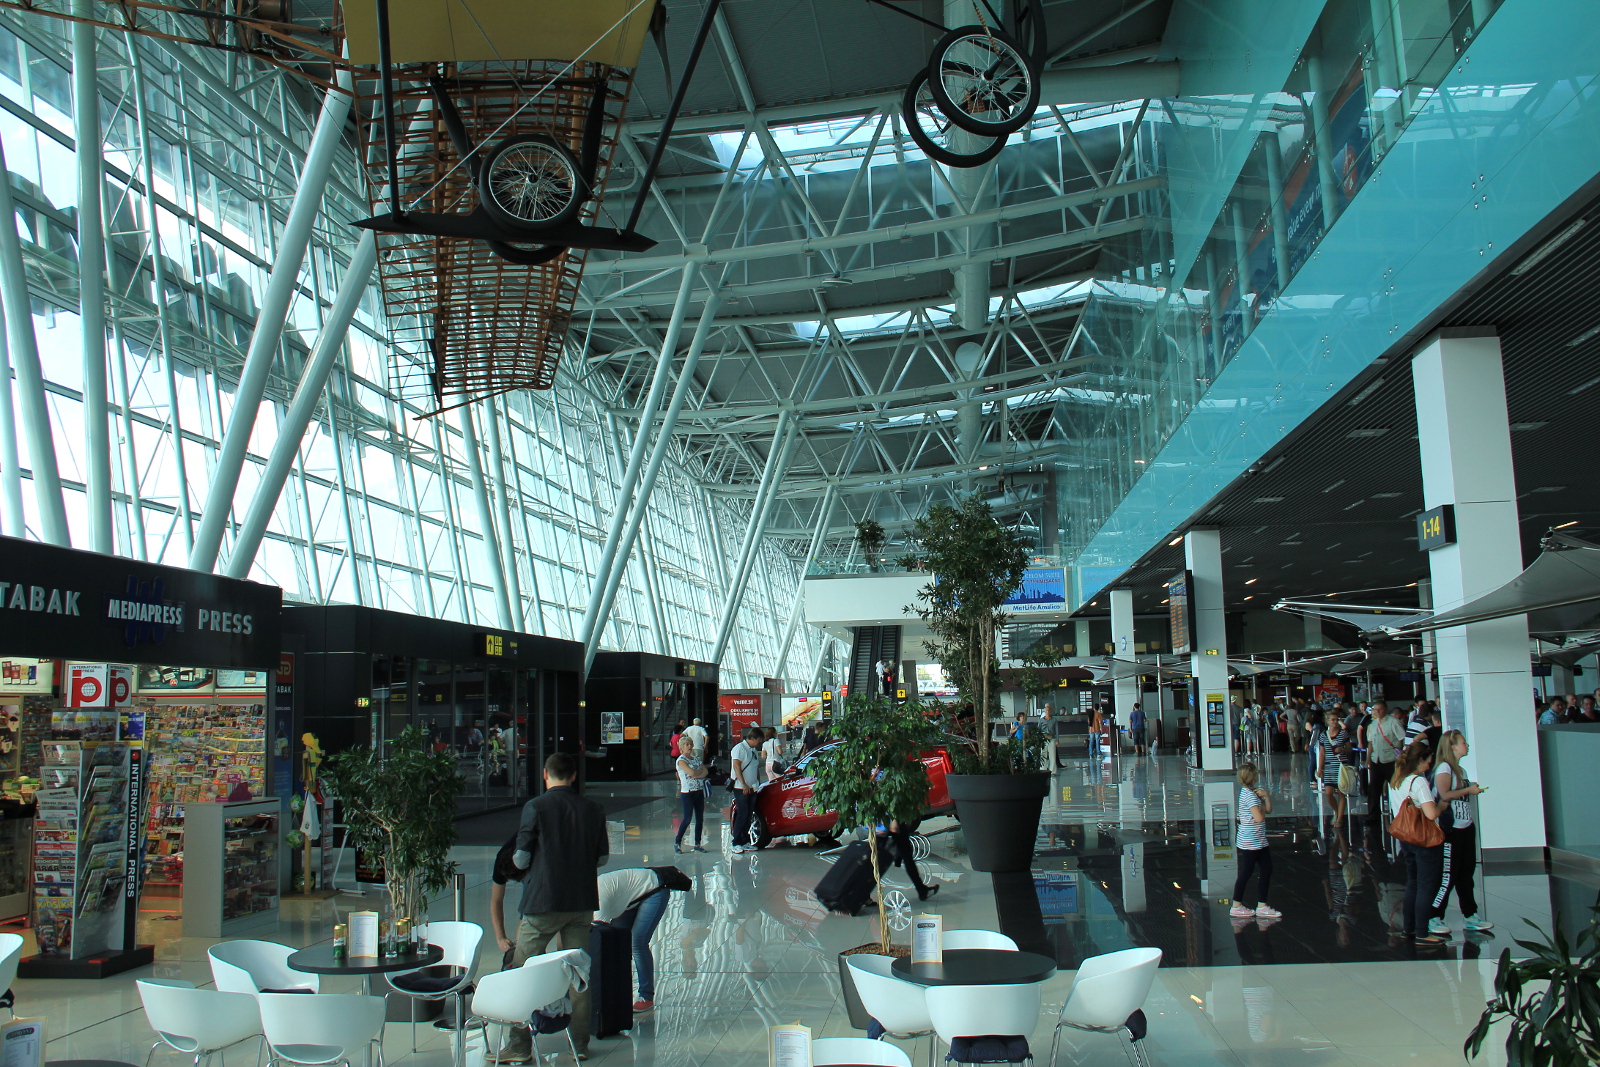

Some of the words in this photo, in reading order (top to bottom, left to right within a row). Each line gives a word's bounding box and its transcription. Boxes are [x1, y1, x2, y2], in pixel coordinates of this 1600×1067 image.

[1287, 216, 1300, 242] alue
[1422, 515, 1440, 540] 1-14
[0, 581, 81, 616] TABAK
[108, 598, 182, 626] MEDIAPRESS
[198, 608, 253, 635] PRESS
[275, 685, 292, 694] ABAK
[128, 764, 139, 854] INTERNATIONAL
[1444, 842, 1452, 858] STAY
[127, 860, 136, 898] PRESS
[1442, 872, 1450, 887] STAY
